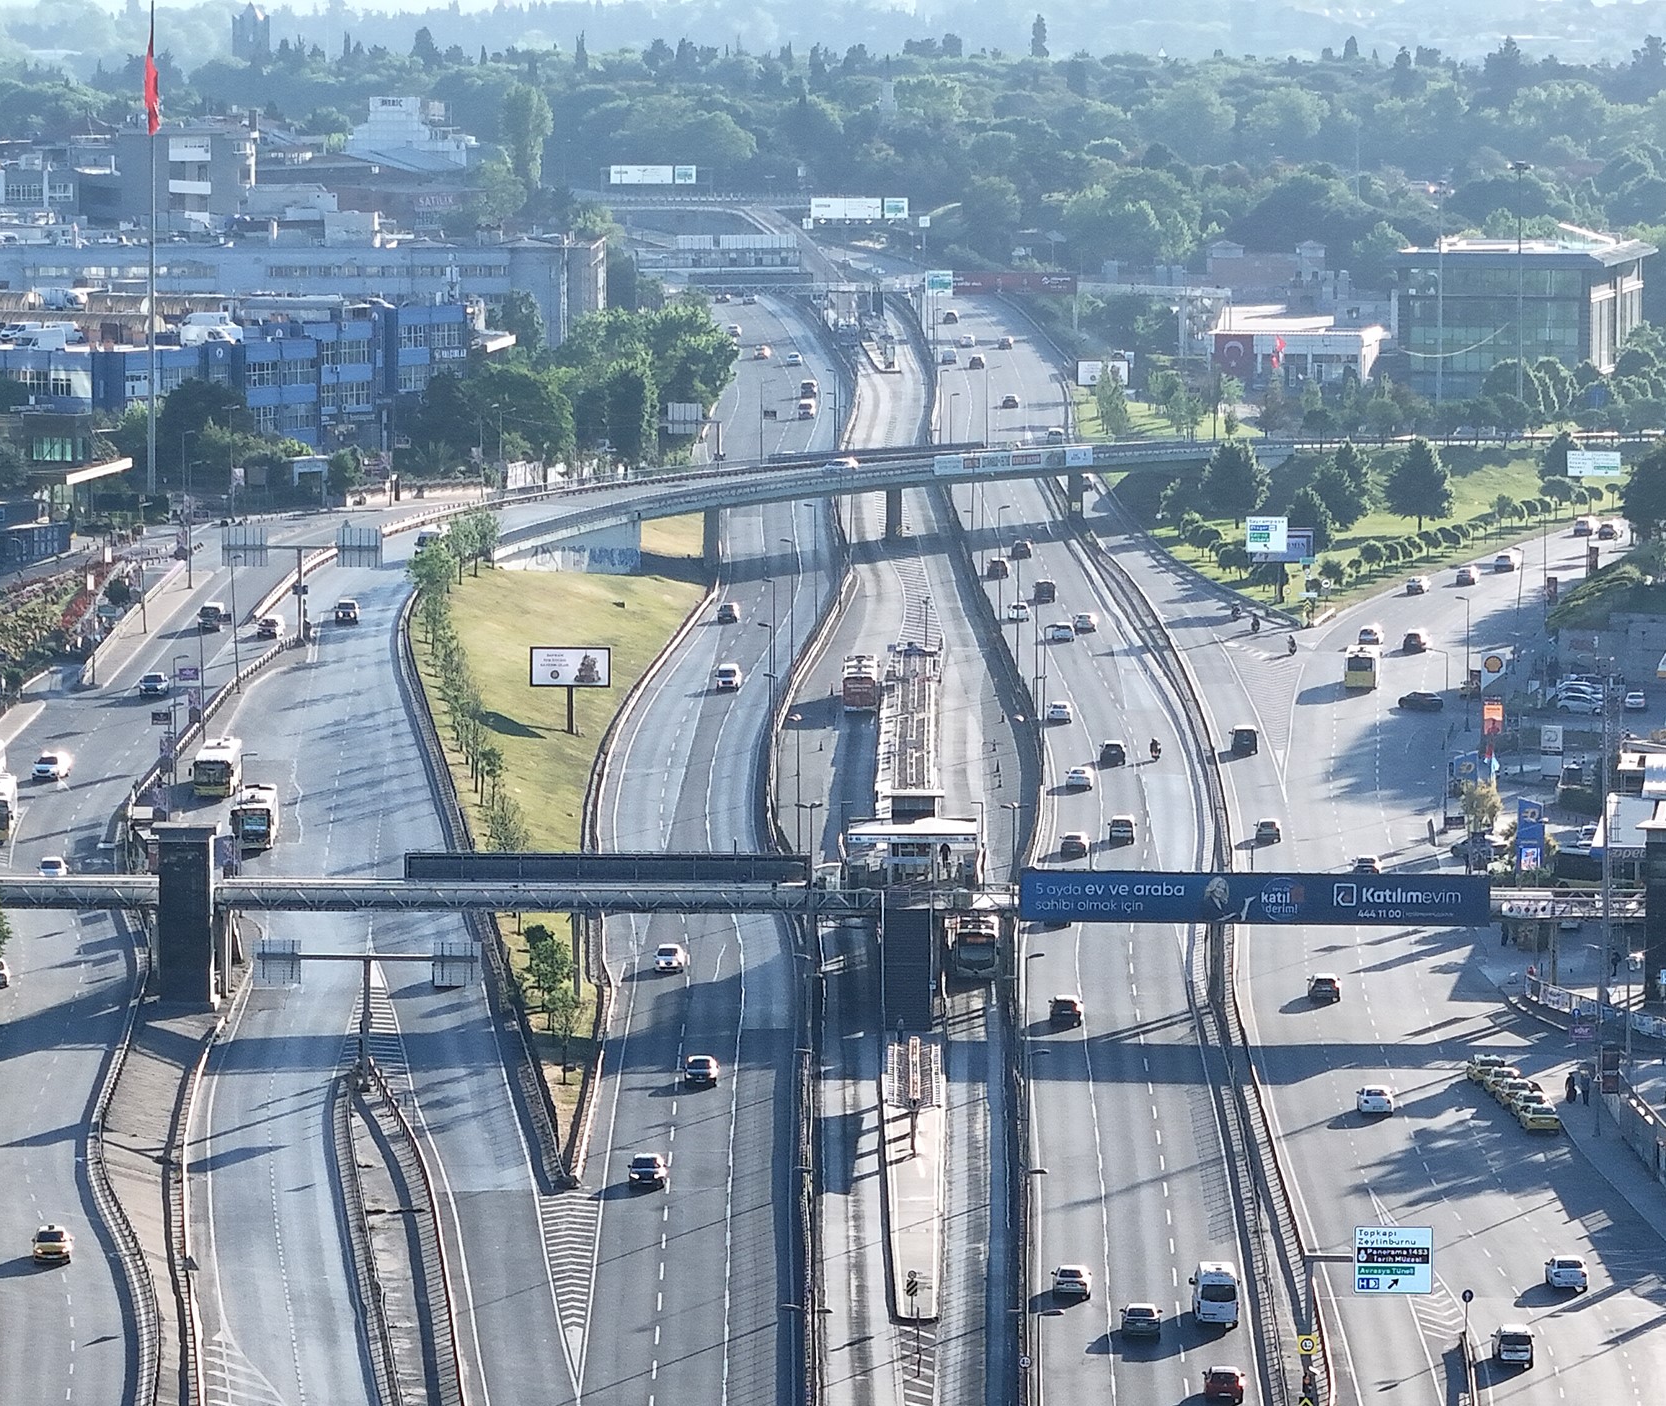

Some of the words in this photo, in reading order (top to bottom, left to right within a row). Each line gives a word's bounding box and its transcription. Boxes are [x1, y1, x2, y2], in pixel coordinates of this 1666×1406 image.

[1035, 883, 1044, 895] 5
[1046, 883, 1082, 897] ayda
[1084, 884, 1104, 896] ev
[1109, 884, 1130, 896] ve
[1133, 882, 1186, 896] araba
[1361, 886, 1462, 904] Katılımevim
[1035, 898, 1075, 911] sahibi
[1077, 899, 1117, 911] olmak
[1120, 899, 1144, 914] için
[1265, 902, 1299, 914] derim!
[1357, 909, 1376, 919] 444
[1377, 909, 1387, 919] 11
[1388, 909, 1402, 919] 00
[1358, 1229, 1397, 1238] Topkapı
[1359, 1267, 1391, 1275] Avrasya
[1359, 1279, 1367, 1288] H
